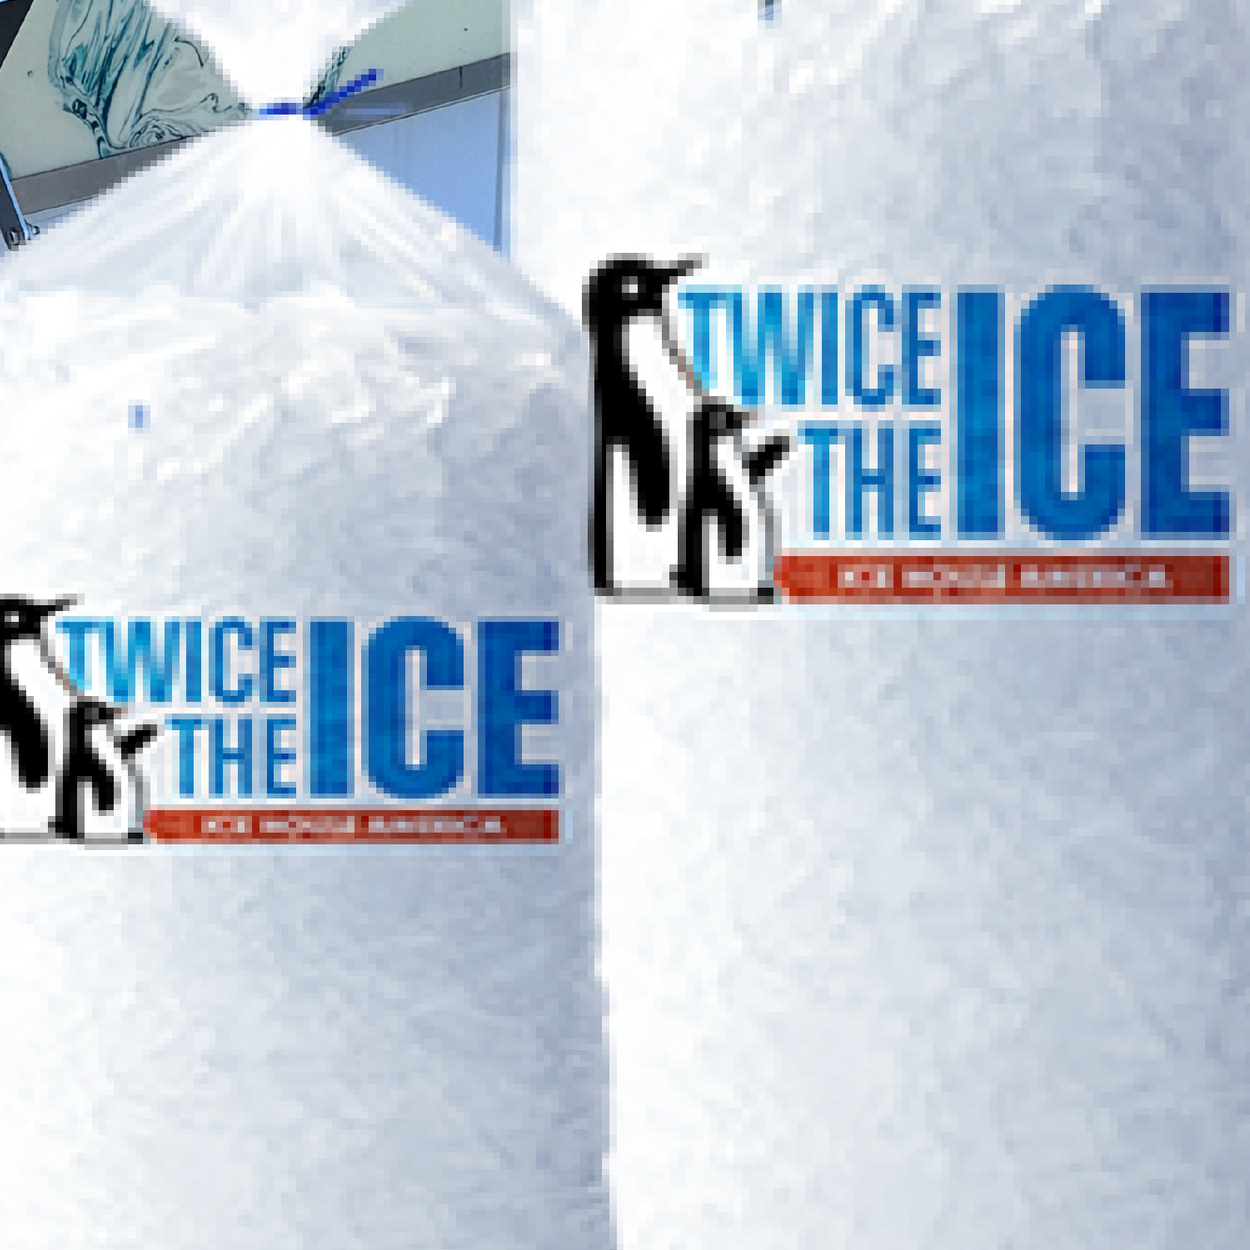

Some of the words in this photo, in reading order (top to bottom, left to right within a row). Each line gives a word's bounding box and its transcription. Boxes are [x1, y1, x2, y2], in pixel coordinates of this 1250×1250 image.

[678, 284, 942, 406] TWICE
[956, 283, 1231, 541] ICE
[797, 420, 942, 541] THE
[56, 615, 297, 703] TWICE
[309, 615, 560, 799] ICE
[164, 713, 297, 798] THE
